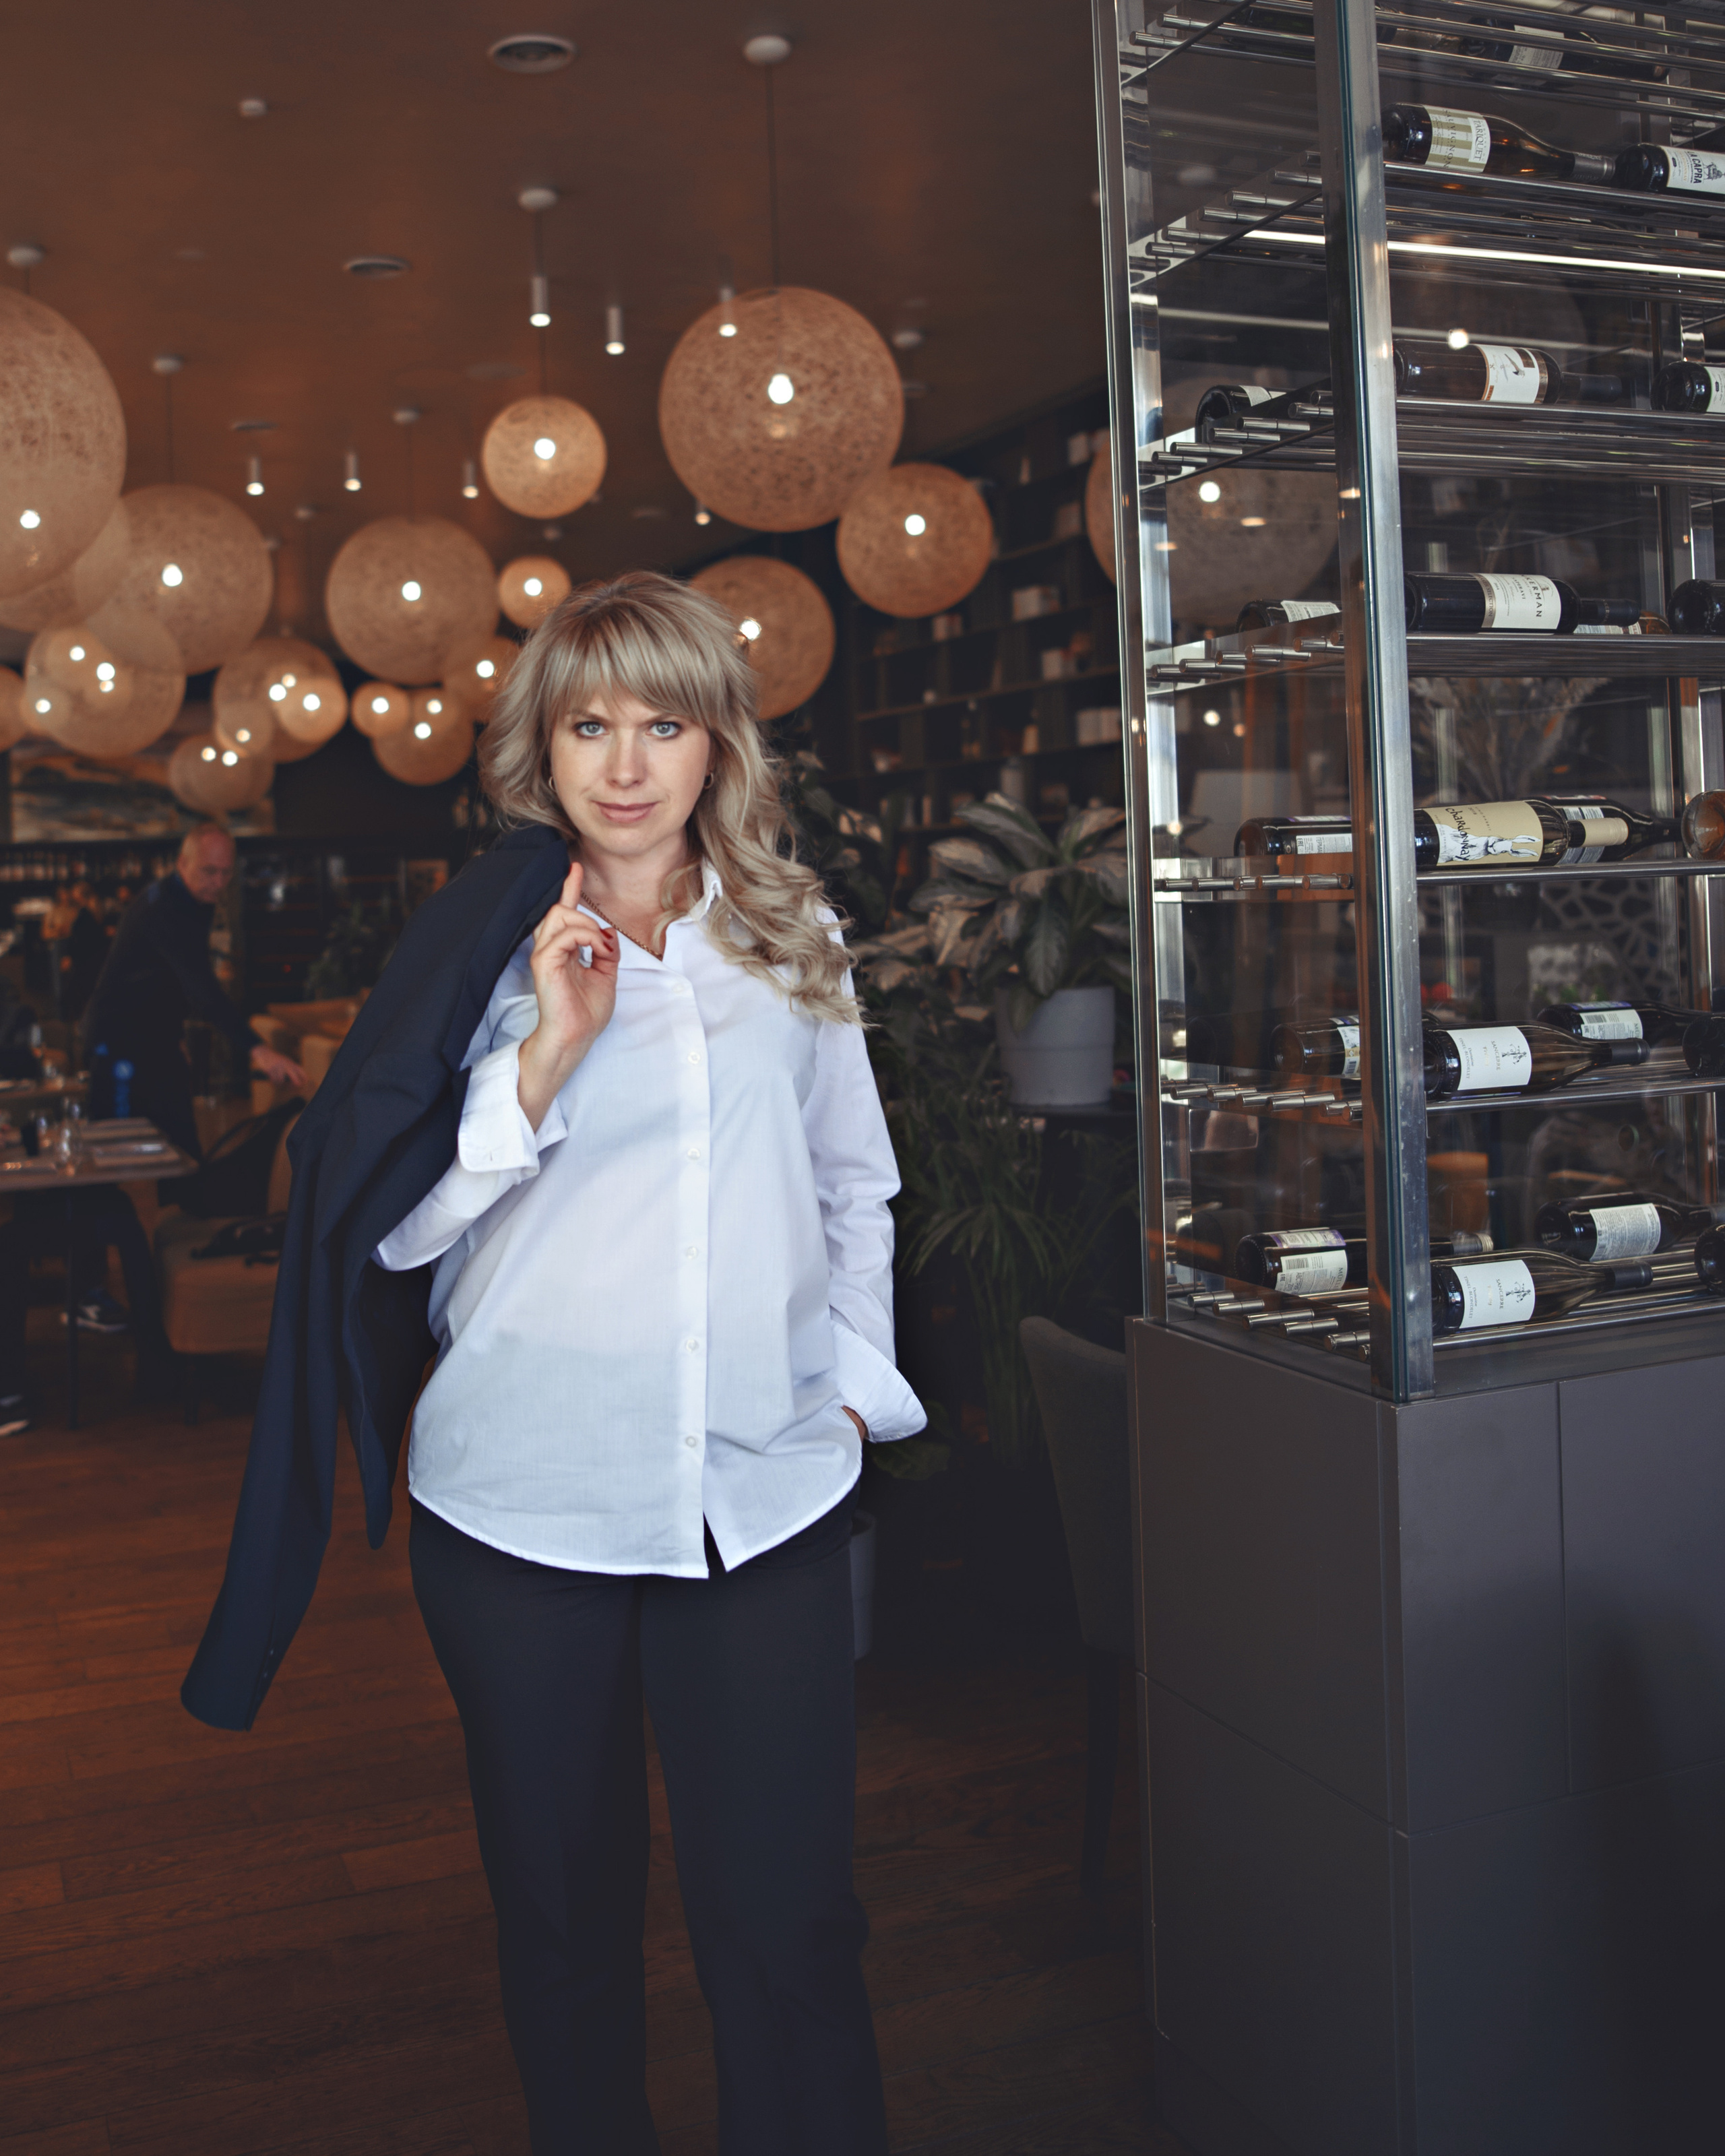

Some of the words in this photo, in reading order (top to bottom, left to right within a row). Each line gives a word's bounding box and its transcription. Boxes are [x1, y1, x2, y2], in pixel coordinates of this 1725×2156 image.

[1474, 120, 1484, 161] TARIQUET
[1692, 158, 1703, 184] CAPRA
[1491, 1040, 1501, 1071] SANCERRE
[1496, 1279, 1504, 1309] SANCERRE
